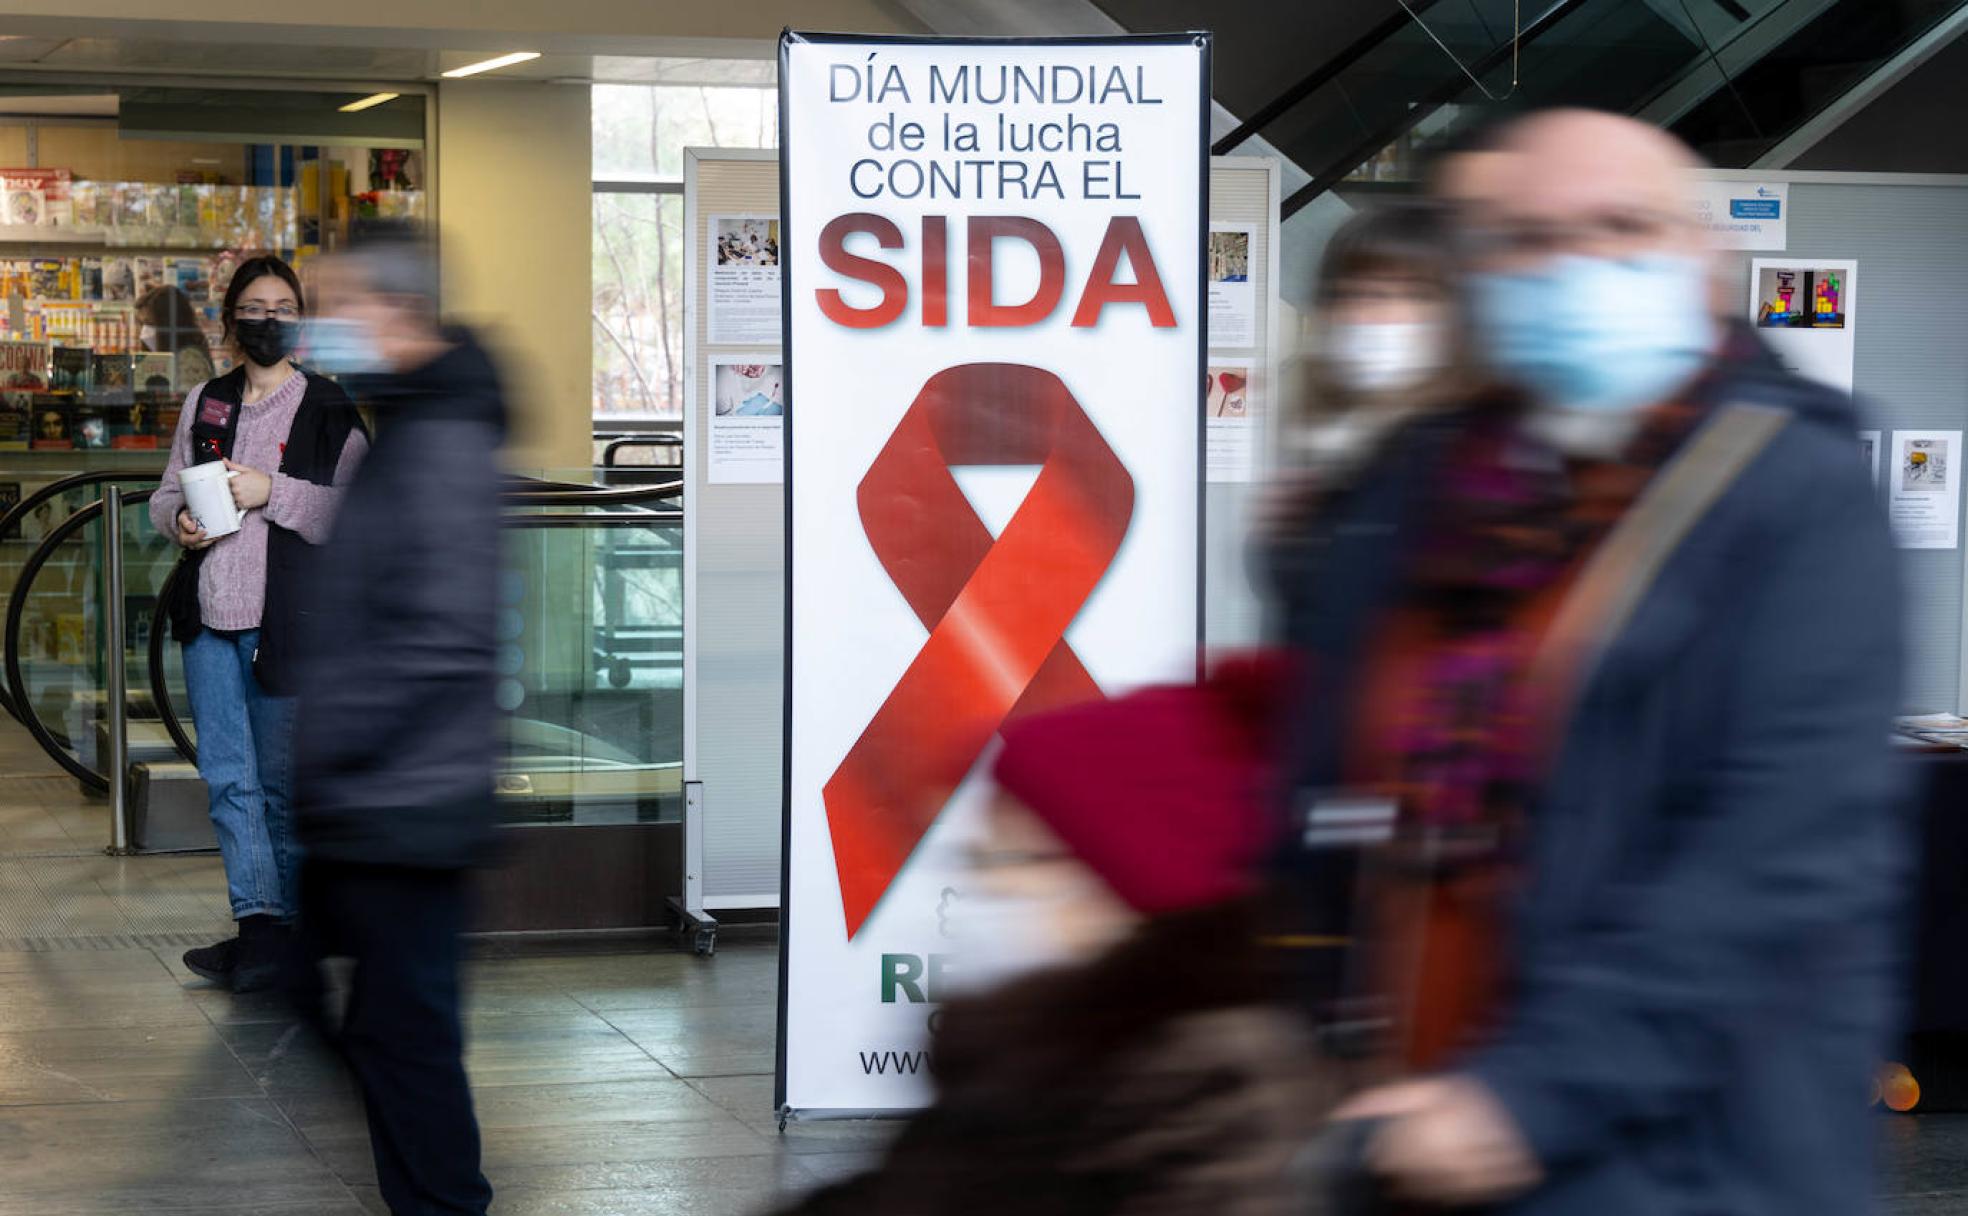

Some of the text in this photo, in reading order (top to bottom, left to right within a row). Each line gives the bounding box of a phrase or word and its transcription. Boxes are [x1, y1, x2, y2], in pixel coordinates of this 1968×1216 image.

[830, 53, 1163, 104] DÍA MUNDIAL
[868, 113, 1122, 153] de la lucha
[850, 159, 1142, 200] CONTRA EL
[815, 212, 1178, 330] SIDA
